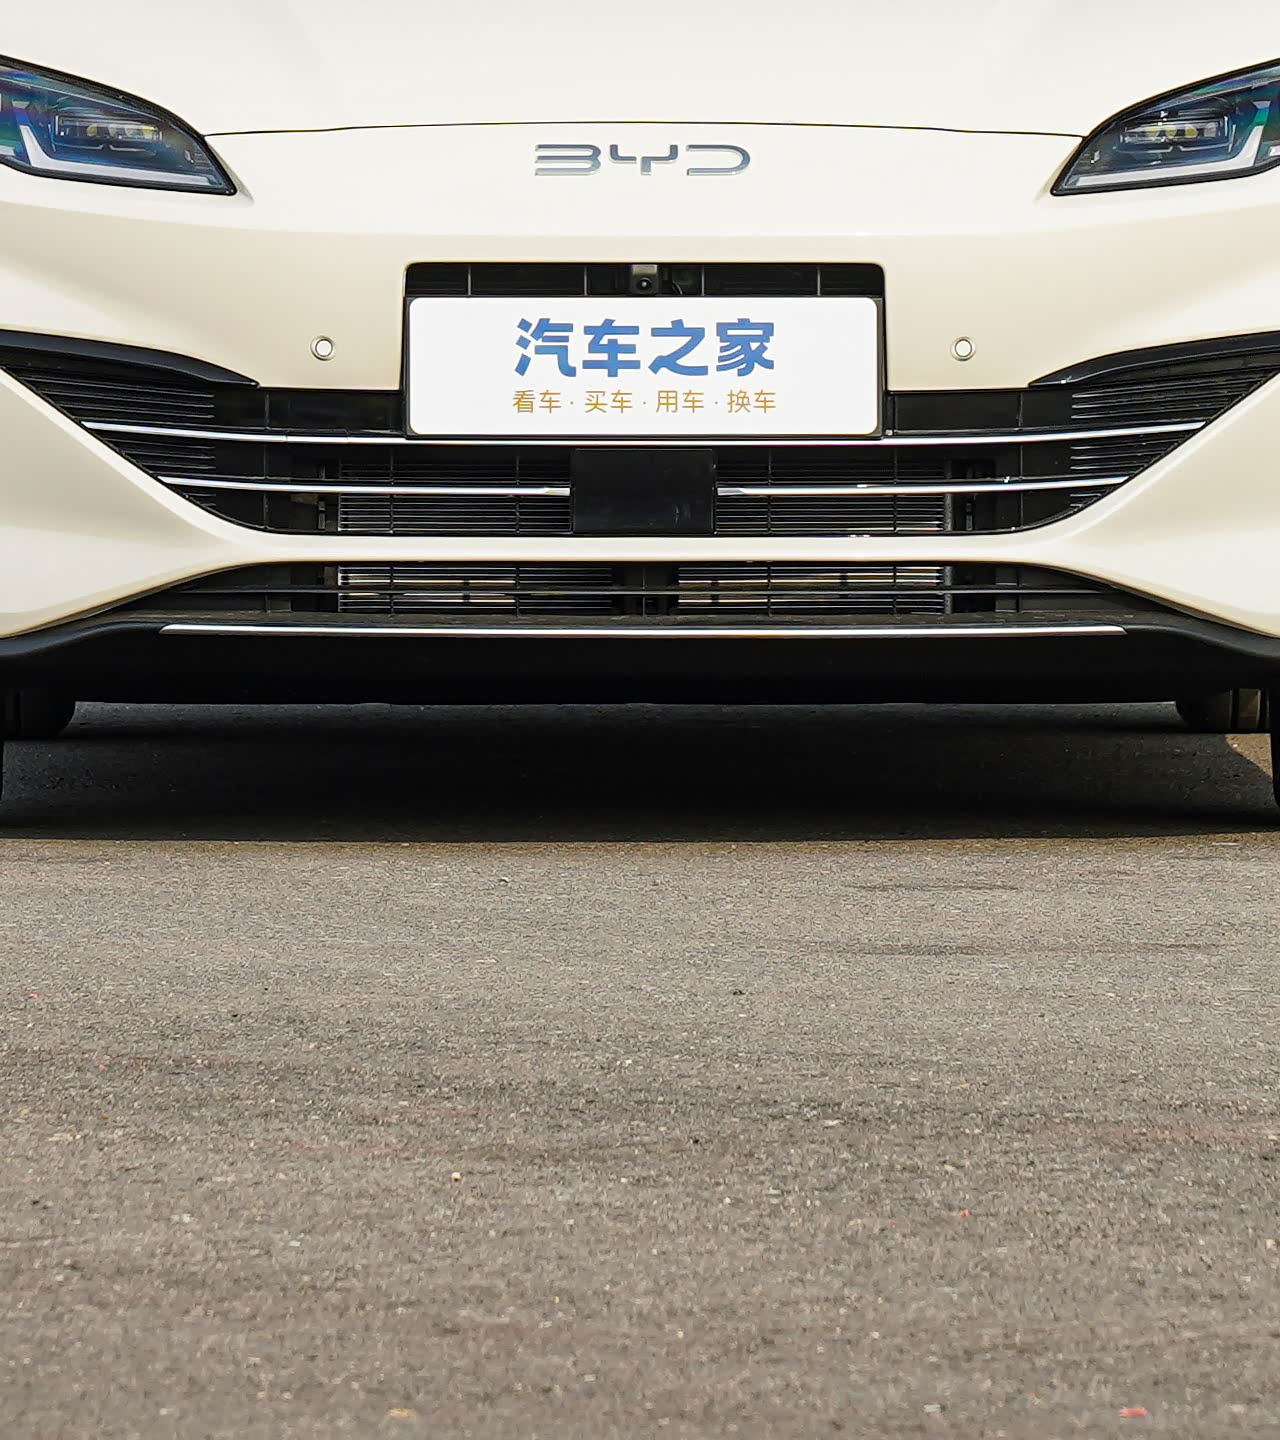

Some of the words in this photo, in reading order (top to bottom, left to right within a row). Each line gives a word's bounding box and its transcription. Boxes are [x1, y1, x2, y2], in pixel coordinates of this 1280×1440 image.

[534, 143, 751, 177] BYD
[514, 318, 775, 378] 汽车之家
